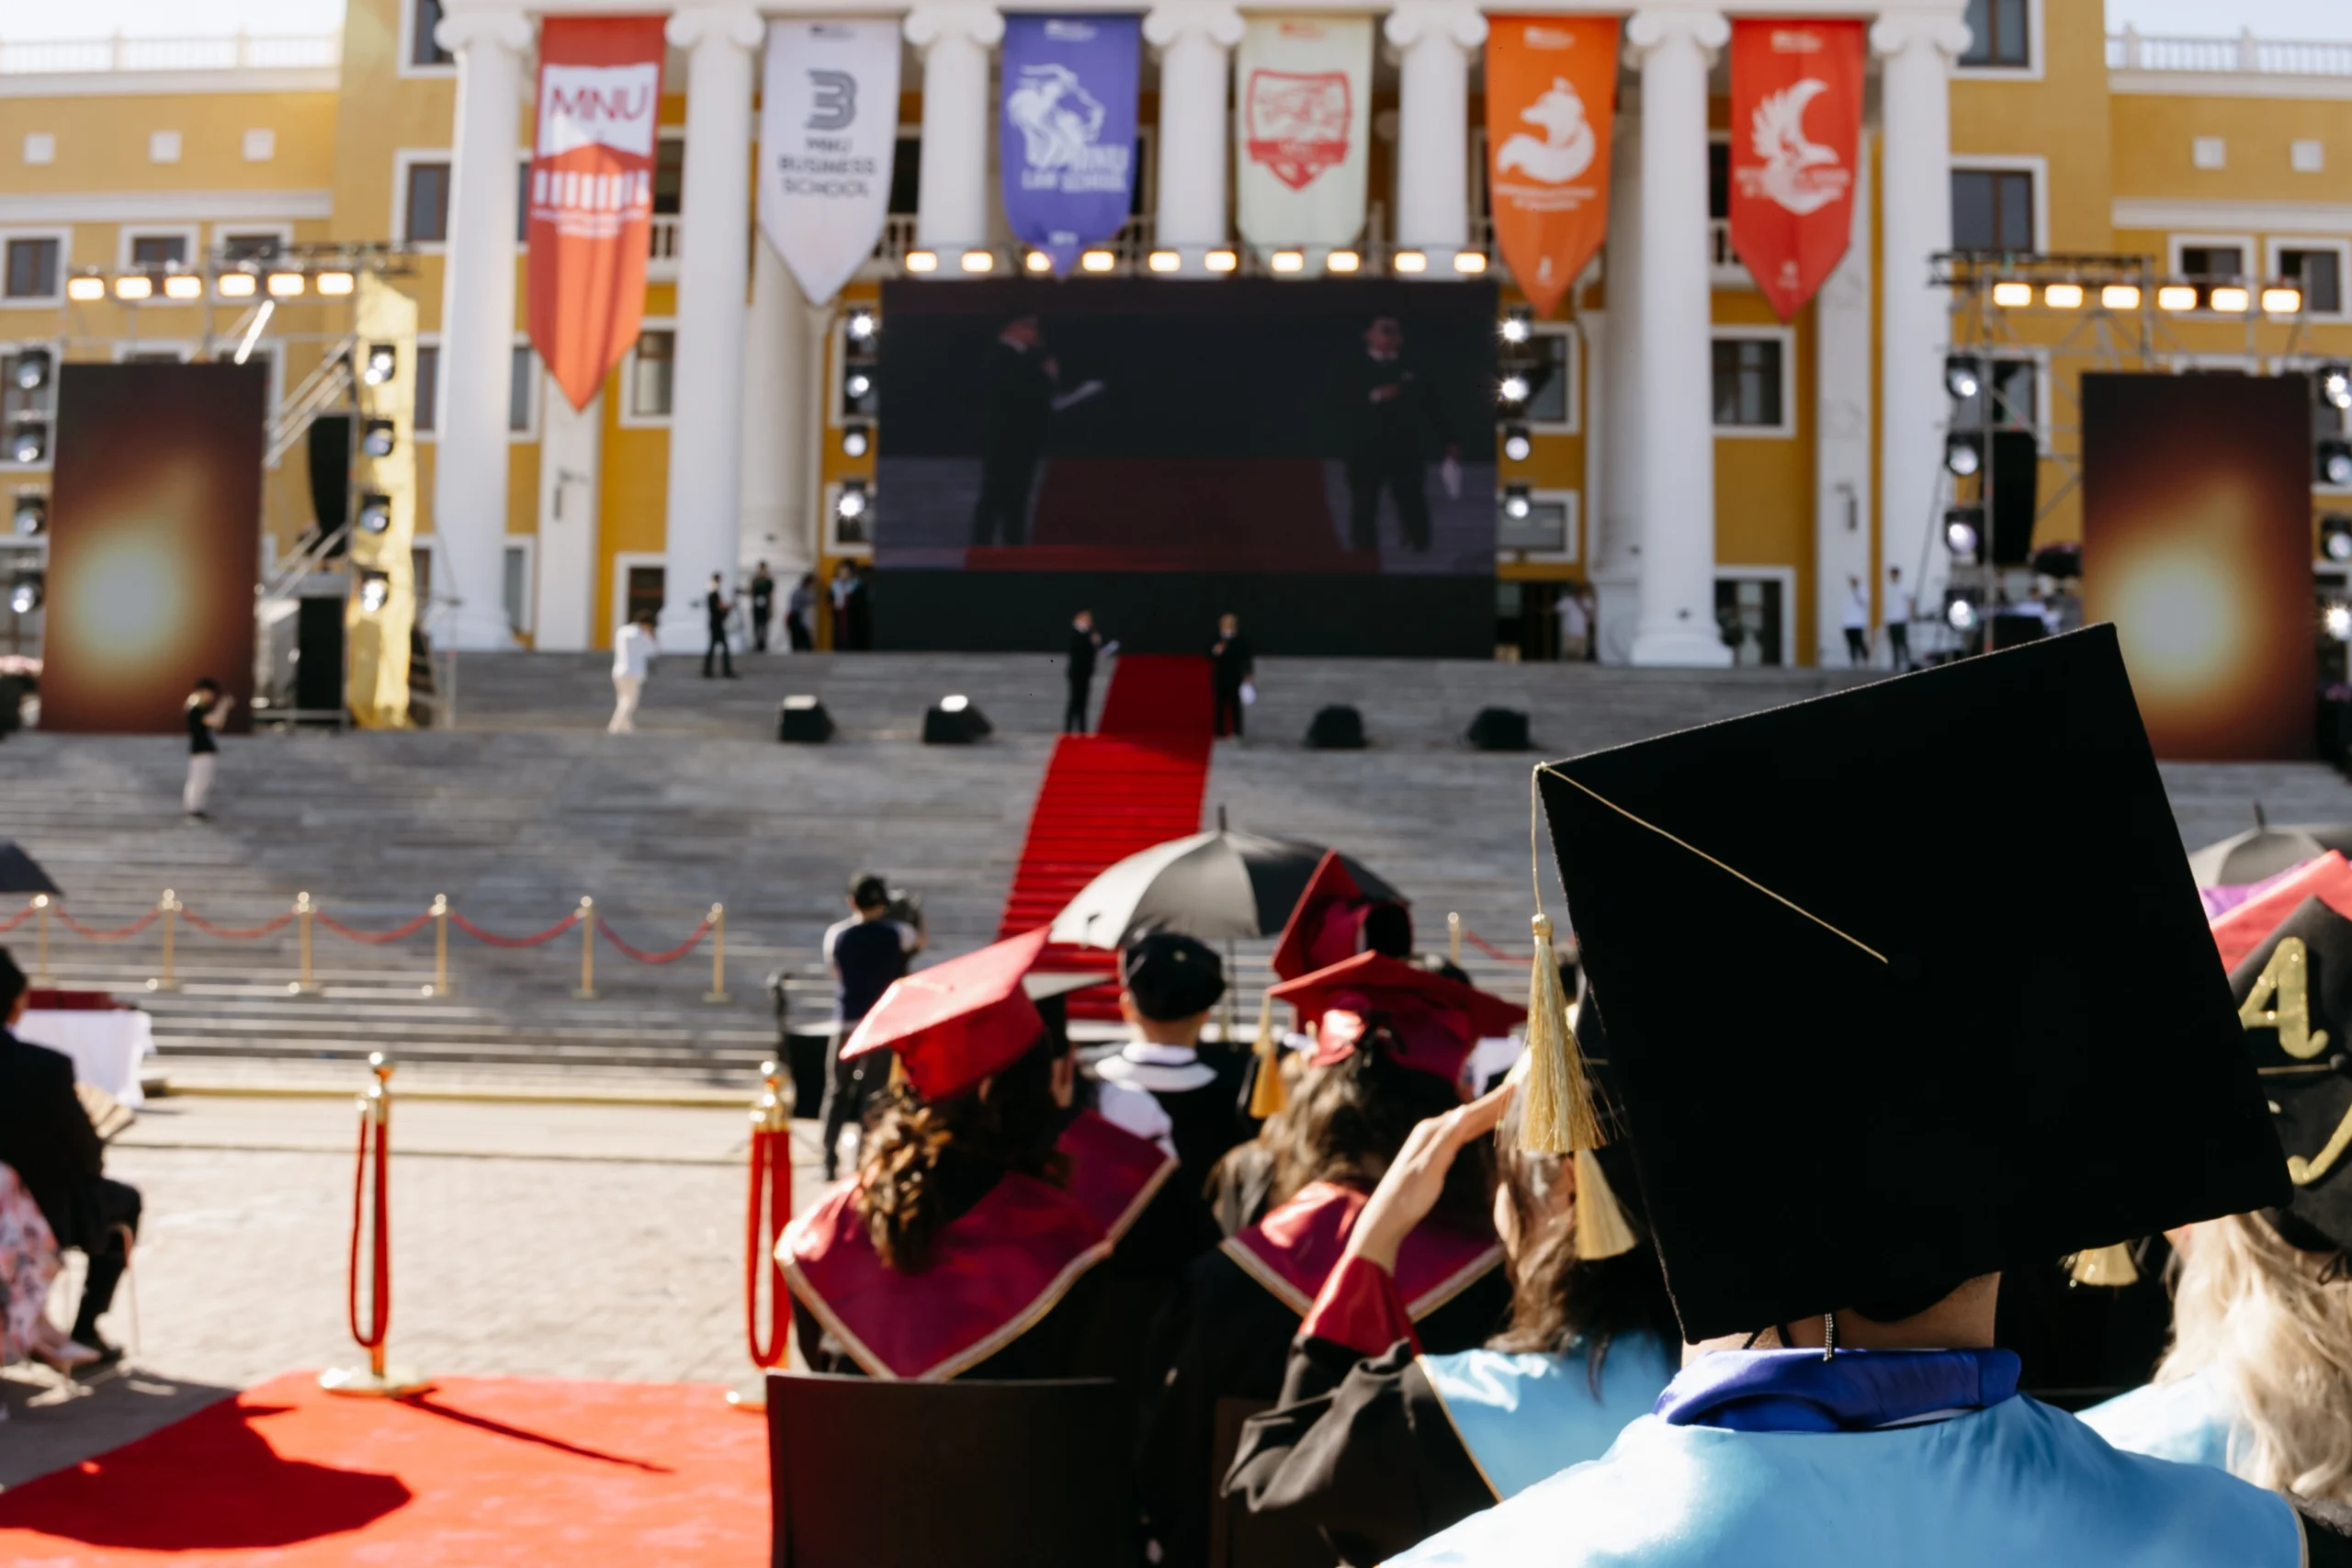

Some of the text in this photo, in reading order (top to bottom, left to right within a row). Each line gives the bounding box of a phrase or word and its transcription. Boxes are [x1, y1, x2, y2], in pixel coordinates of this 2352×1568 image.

[549, 85, 650, 121] MNU
[779, 157, 877, 175] BUSINESS
[784, 178, 869, 198] SCHOOL
